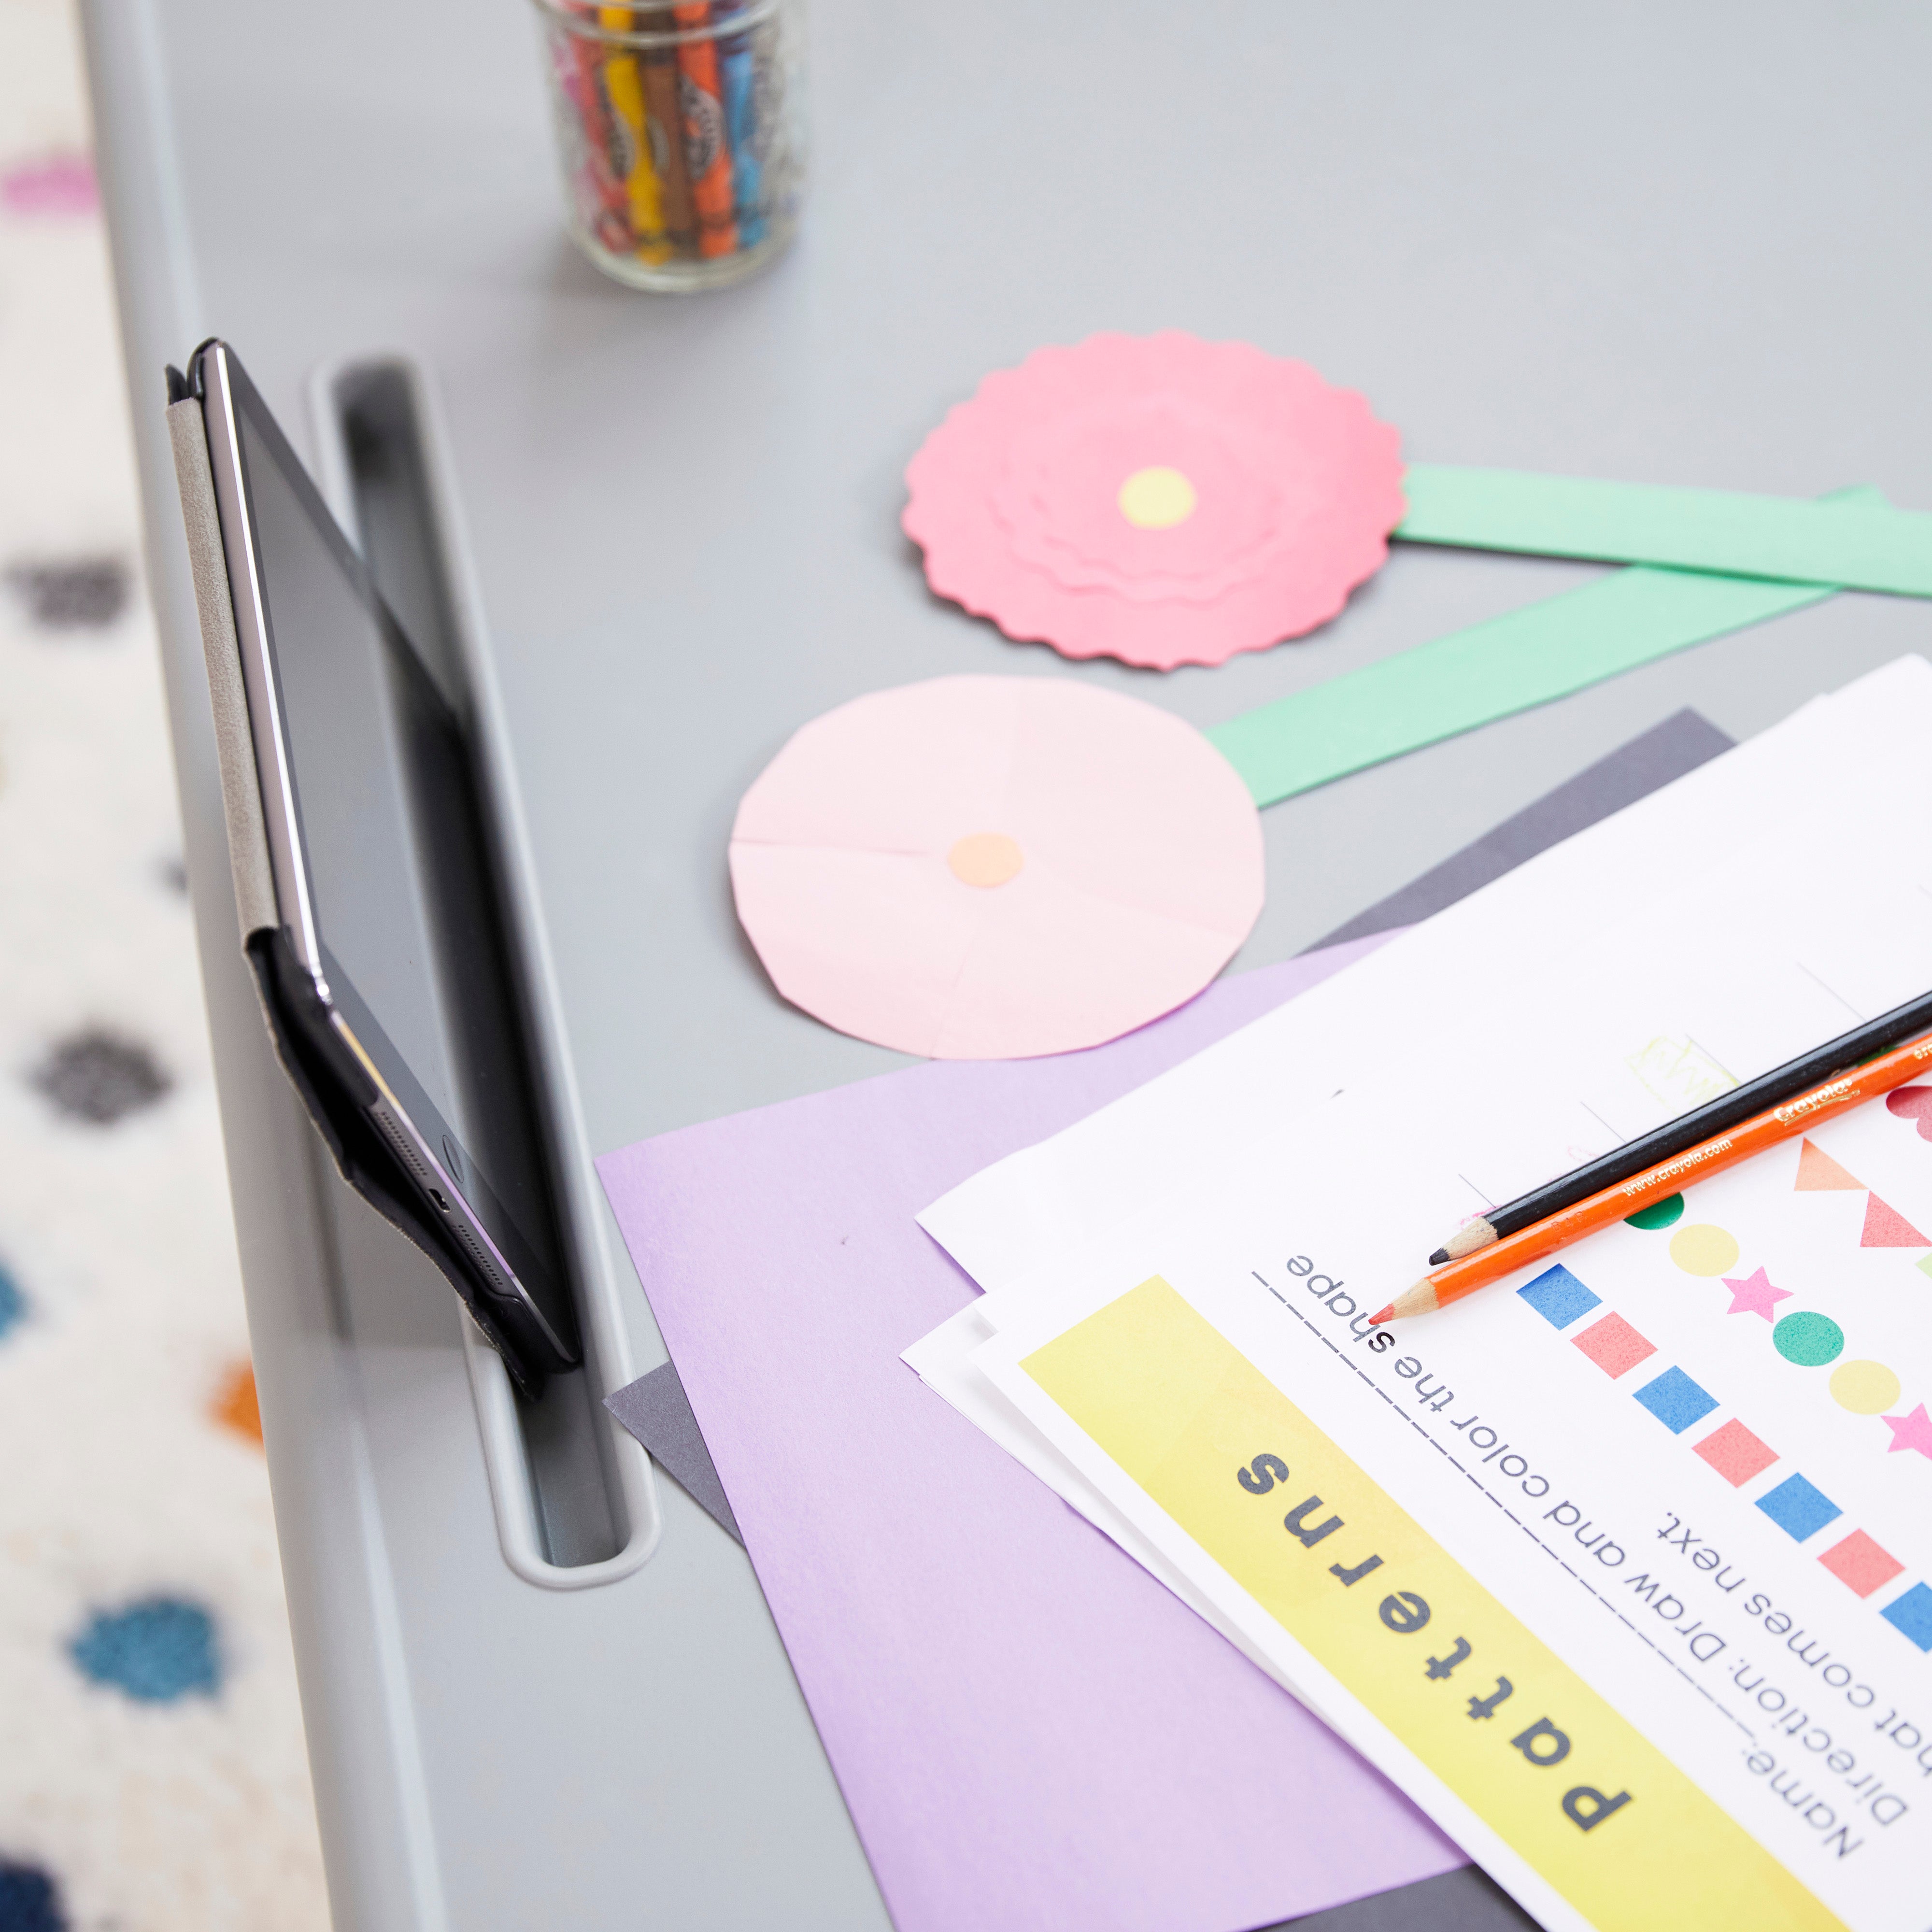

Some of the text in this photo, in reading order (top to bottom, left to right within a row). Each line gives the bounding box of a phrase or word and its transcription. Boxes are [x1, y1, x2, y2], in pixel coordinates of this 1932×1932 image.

[1622, 1138, 1733, 1197] www.crayola.com
[1237, 1453, 1633, 1833] Patterns
[1287, 1256, 1908, 1826] Direction: Draw and color the shape
[1658, 1512, 1932, 1776] hat comes next.
[1742, 1742, 1862, 1858] Name:
